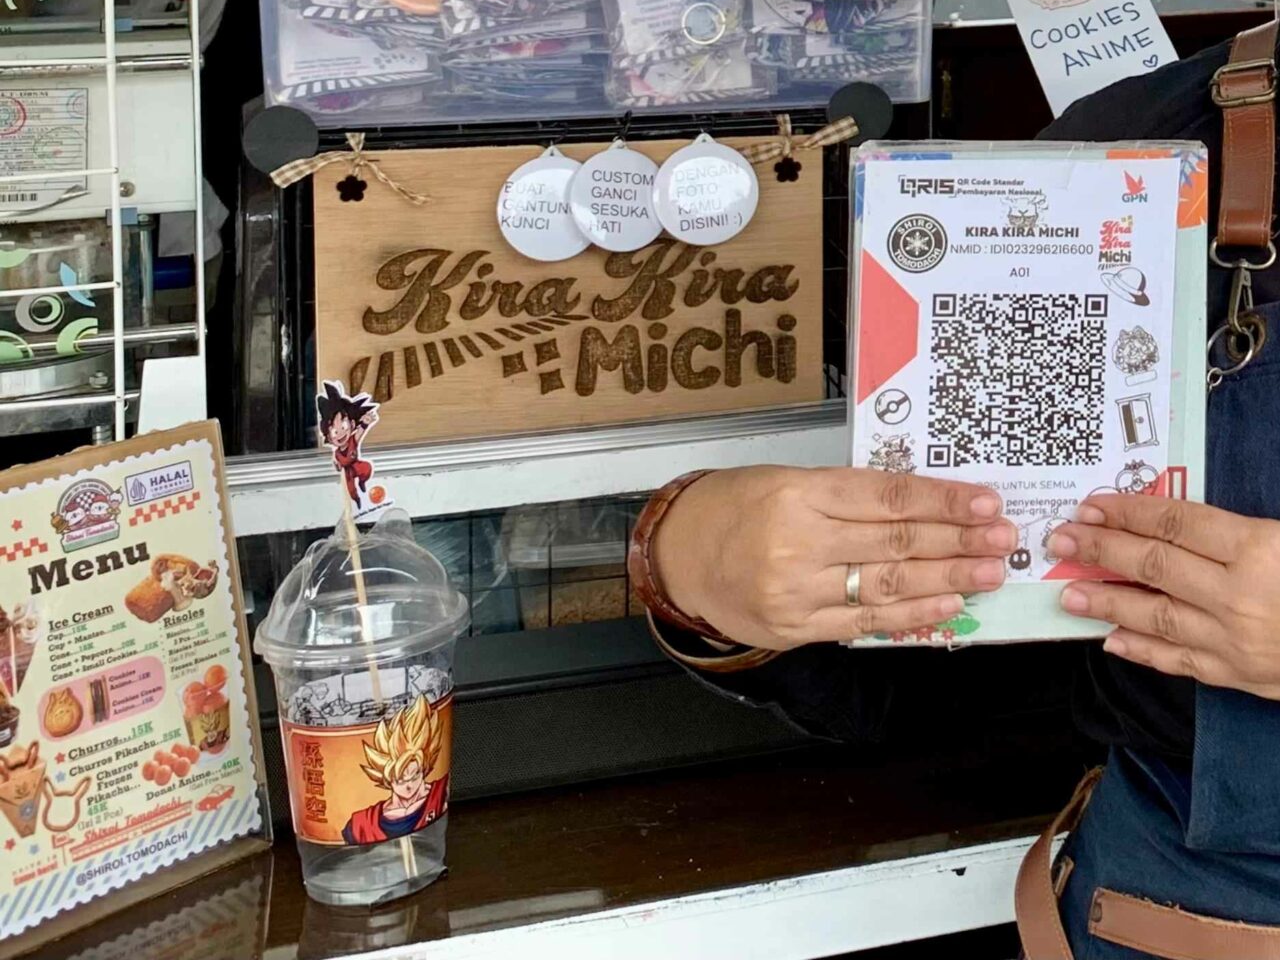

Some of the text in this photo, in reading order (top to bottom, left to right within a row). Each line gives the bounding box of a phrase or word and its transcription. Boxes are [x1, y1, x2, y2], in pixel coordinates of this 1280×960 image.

[1030, 1, 1141, 49] COOKIES
[1062, 27, 1154, 76] ANIME
[591, 169, 654, 186] CUSTOM
[674, 162, 740, 182] DENGAN
[677, 182, 718, 198] FOTO
[900, 178, 955, 198] QRIS
[957, 178, 1025, 187] QR Code Standar
[591, 186, 637, 201] GANCI
[957, 188, 1042, 197] Pembayaran Nasional
[1122, 192, 1148, 203] GPN
[503, 200, 572, 215] GANTUN
[590, 202, 649, 219] SESUKA
[501, 215, 550, 230] KUNCI
[589, 220, 622, 233] HATI
[680, 214, 729, 232] DISINI!
[897, 218, 938, 235] SHIROI
[1099, 220, 1133, 235] Kira
[965, 226, 1080, 238] KIRA KIRA MICHI
[950, 243, 1094, 256] NMID ID1023296216600
[1099, 236, 1132, 250] Kira
[894, 247, 943, 270] TOMODACHI
[1098, 250, 1132, 263] Michi
[1009, 267, 1030, 278] A01
[362, 238, 800, 335] Kira Kira
[575, 308, 798, 397] Michi
[150, 469, 189, 487] HALAL
[1002, 480, 1077, 490] UNTUK SEMUA
[1006, 498, 1078, 507] penyelenggara
[28, 541, 151, 595] Menu
[49, 603, 115, 632] Ice Cream
[163, 607, 205, 628] Risoles
[69, 757, 113, 778] Churros
[96, 760, 139, 782] Churros
[96, 773, 133, 791] Frozen
[145, 785, 177, 802] Donat
[75, 830, 189, 887] @SHIROI.TOMODACHI
